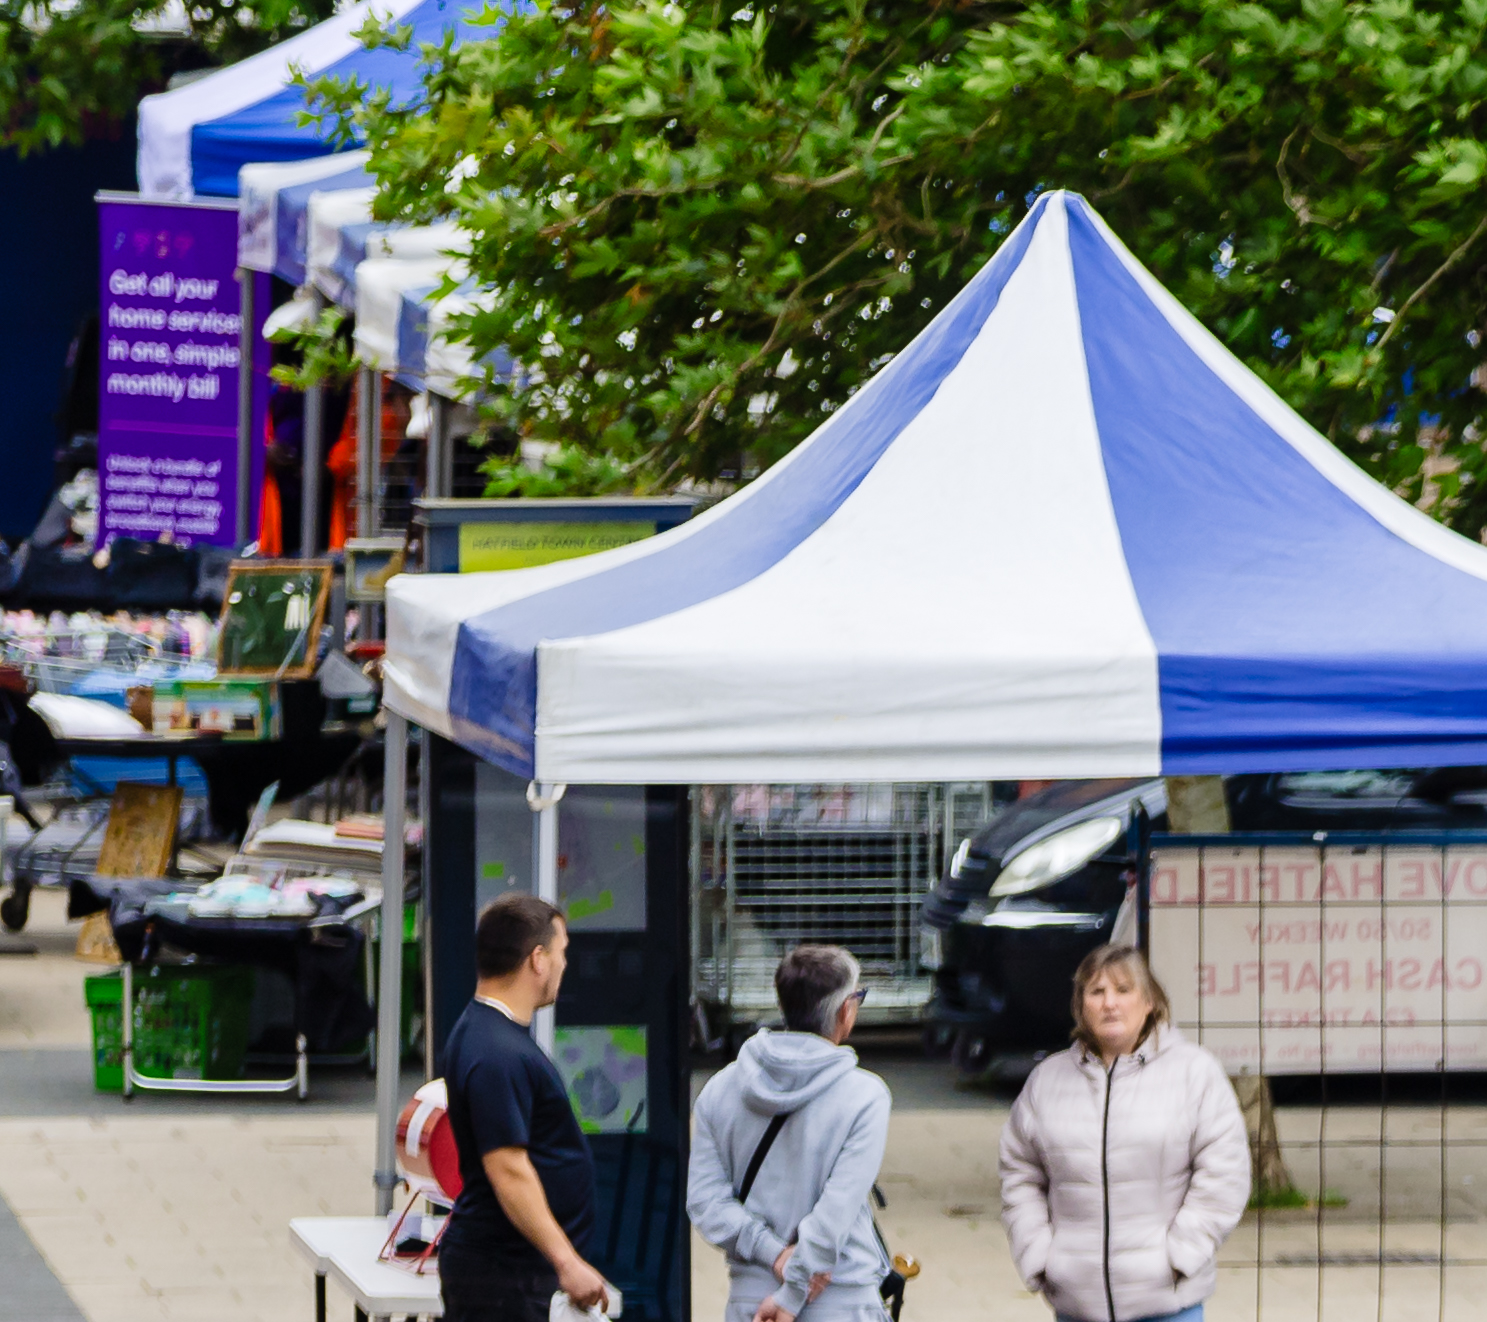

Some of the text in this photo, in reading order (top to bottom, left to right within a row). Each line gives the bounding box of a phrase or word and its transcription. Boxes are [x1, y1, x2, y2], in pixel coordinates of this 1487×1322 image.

[109, 269, 219, 303] Get all your
[109, 302, 167, 330] home
[108, 335, 129, 361] in
[174, 339, 240, 371] simple
[107, 371, 219, 403] monthly bill
